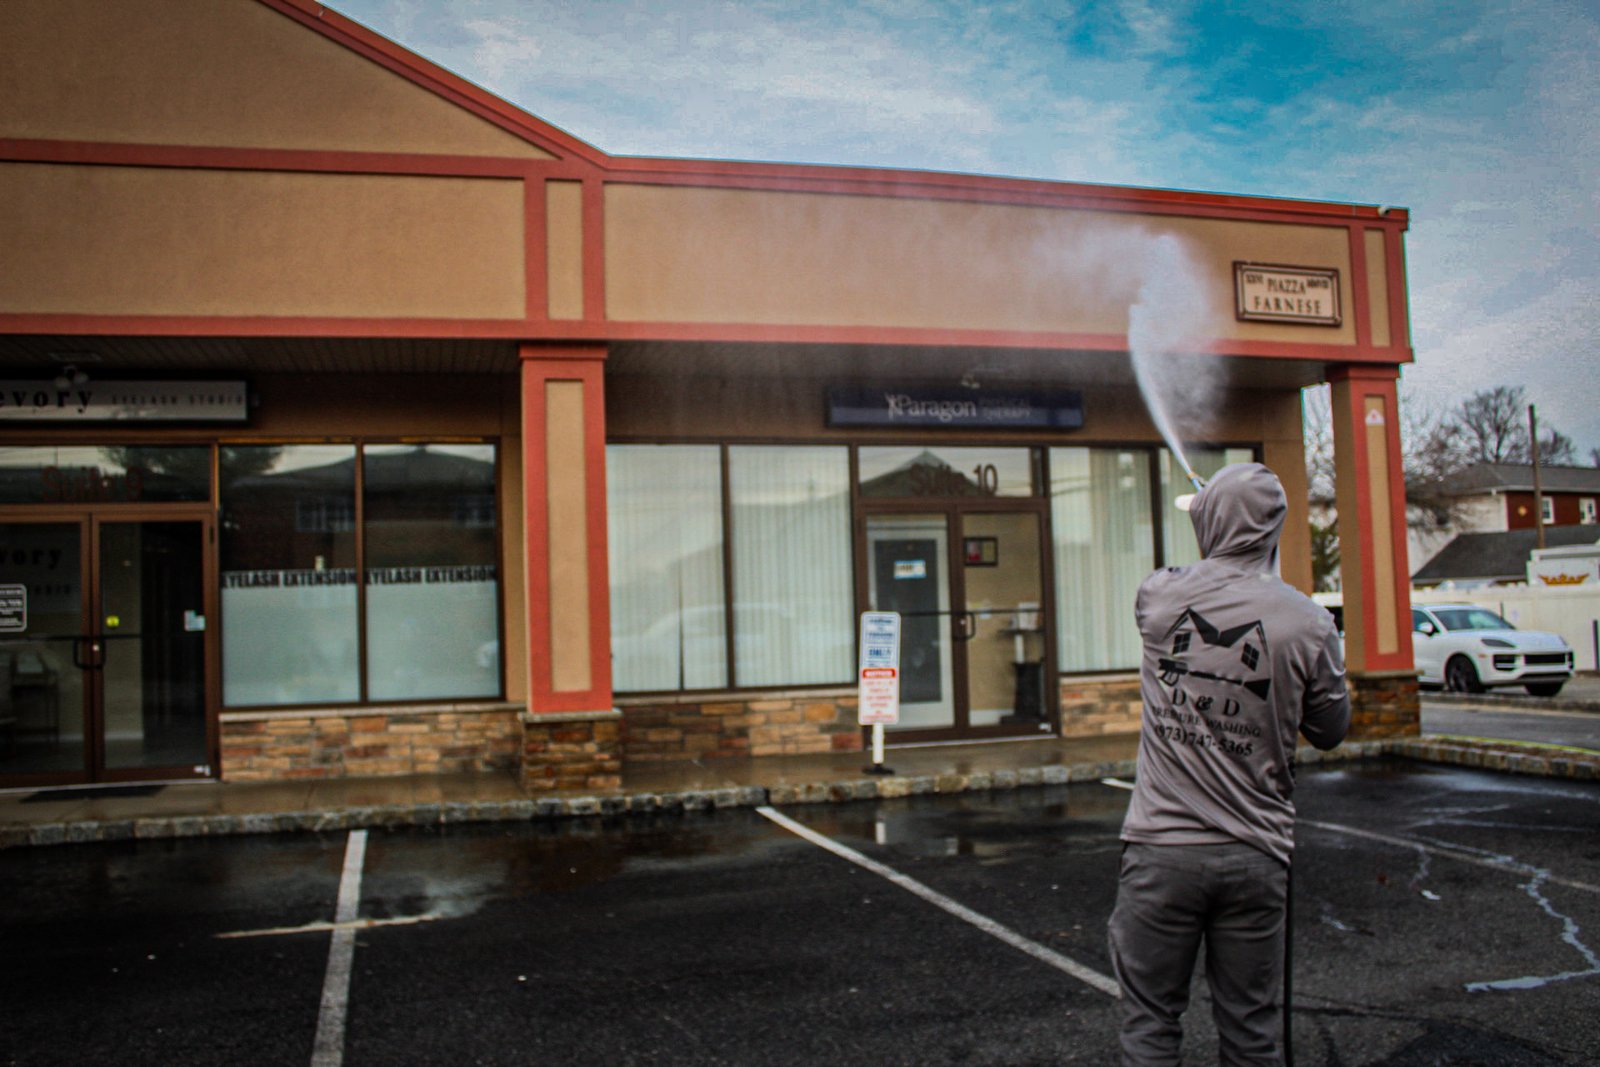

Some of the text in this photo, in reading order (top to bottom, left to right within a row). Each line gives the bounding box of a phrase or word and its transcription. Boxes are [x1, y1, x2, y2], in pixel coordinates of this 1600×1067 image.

[1267, 278, 1306, 294] PIAZZA
[1254, 296, 1321, 314] FARNESE
[896, 394, 977, 422] Paragon
[973, 463, 998, 496] 10
[1172, 688, 1240, 717] D & D
[1206, 718, 1262, 738] WASHING
